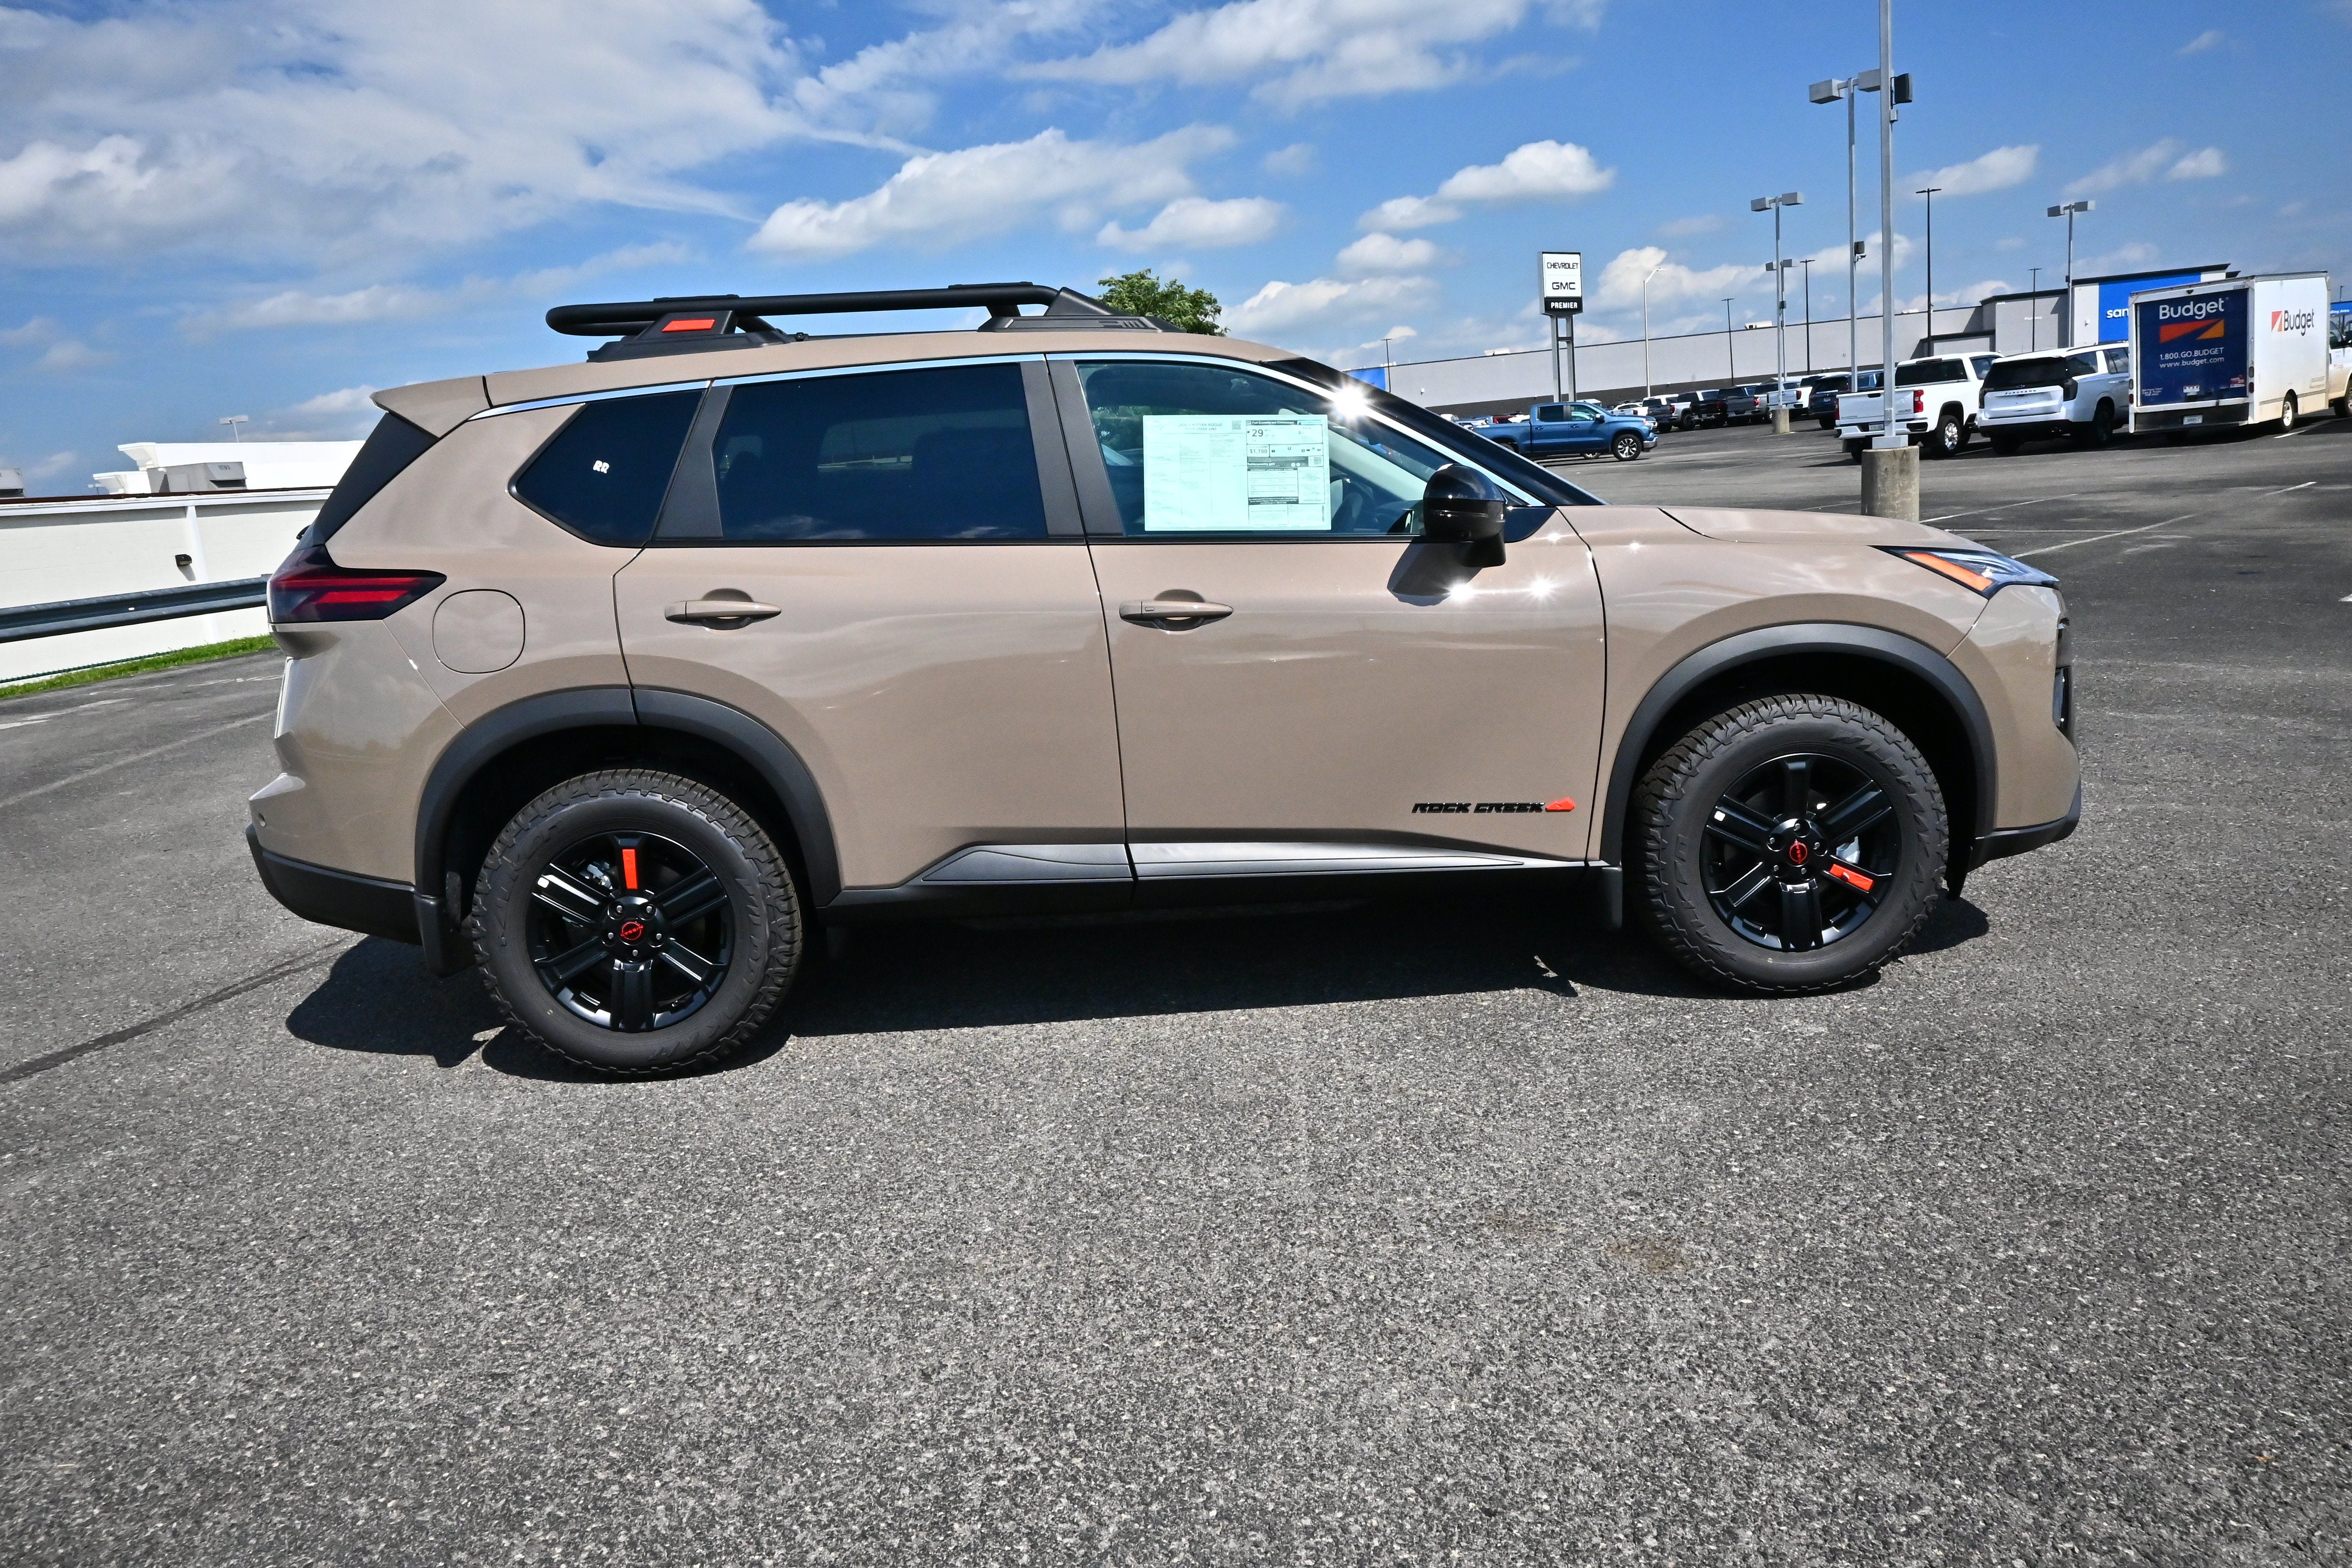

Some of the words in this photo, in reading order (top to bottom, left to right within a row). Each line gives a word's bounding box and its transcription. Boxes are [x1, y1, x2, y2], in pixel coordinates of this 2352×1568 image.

[2159, 298, 2224, 319] Budget
[2284, 308, 2314, 336] Budget
[2160, 347, 2224, 360] 1.800.GO.BUDGET
[2160, 357, 2224, 368] www.budget.com
[593, 460, 610, 474] RR
[1412, 803, 1472, 813] ROCK
[1473, 803, 1545, 813] CREEK
